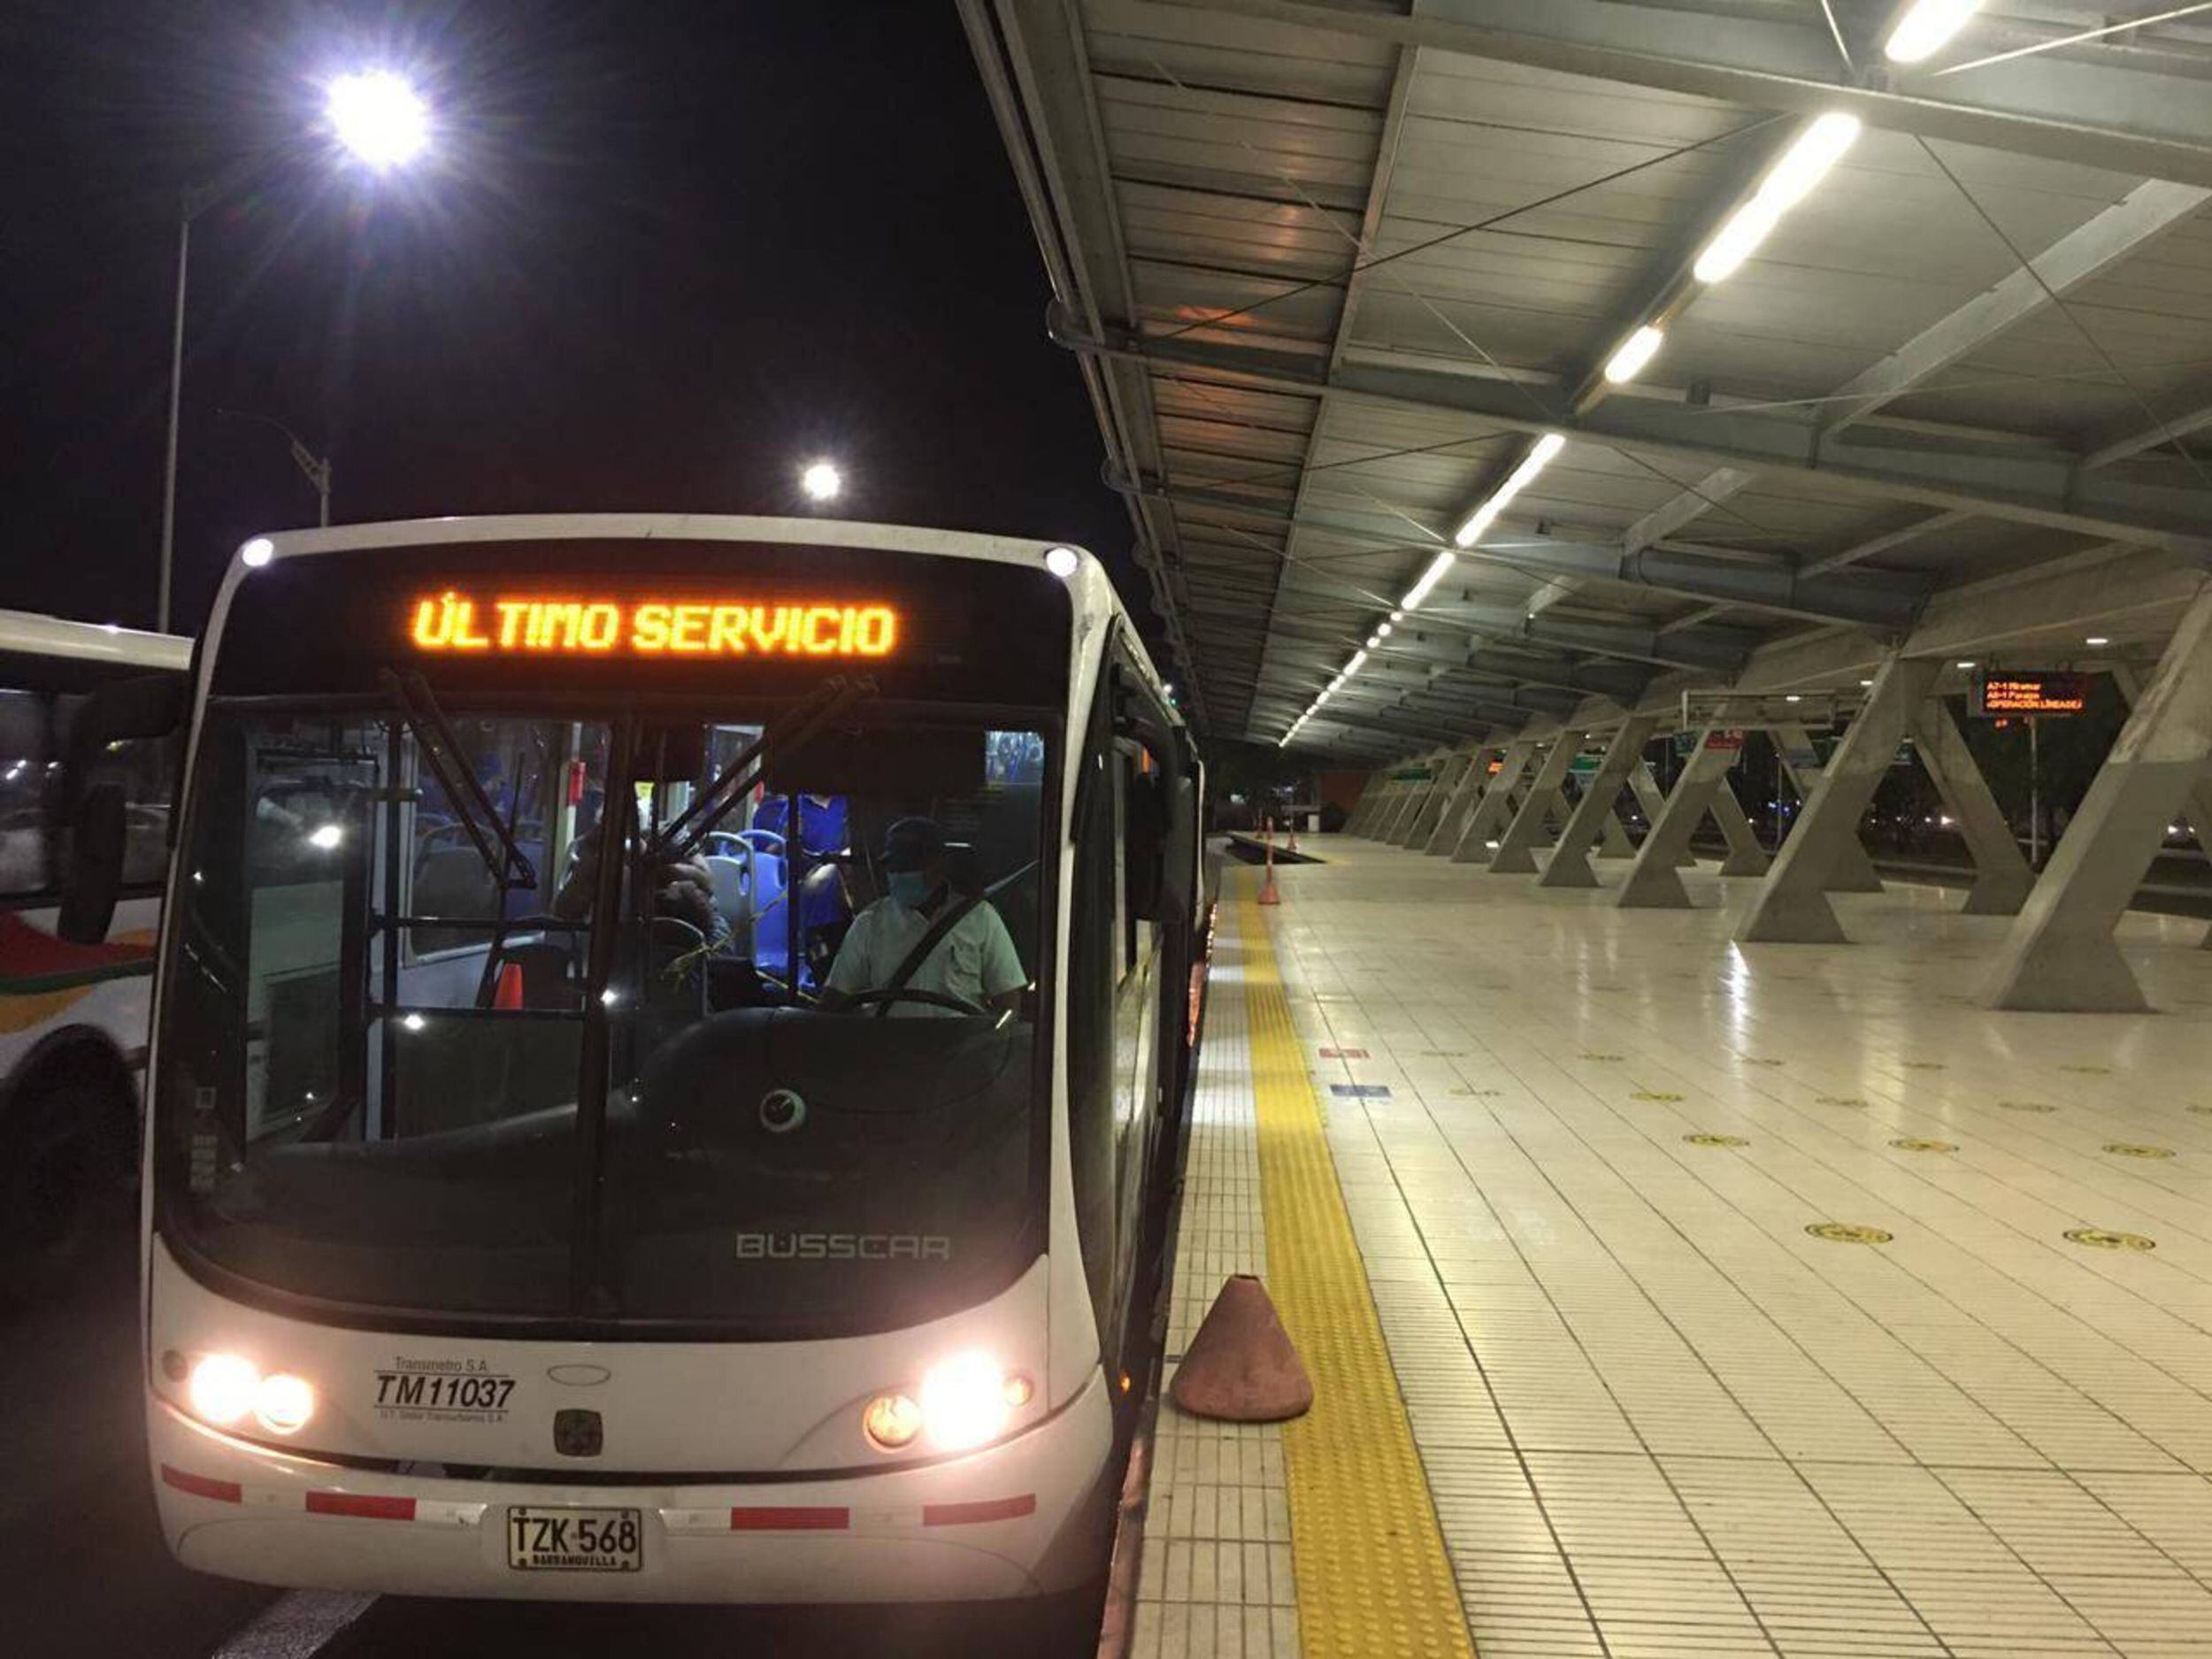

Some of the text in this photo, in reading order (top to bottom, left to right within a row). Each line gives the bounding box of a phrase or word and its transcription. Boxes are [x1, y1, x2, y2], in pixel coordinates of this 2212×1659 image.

[412, 591, 897, 656] ÚLTIMO SERVICIO
[736, 1233, 950, 1259] BUSSCAR
[396, 1356, 462, 1371] Transmetro
[376, 1374, 515, 1409] TM11037
[512, 1517, 636, 1554] TZK 568
